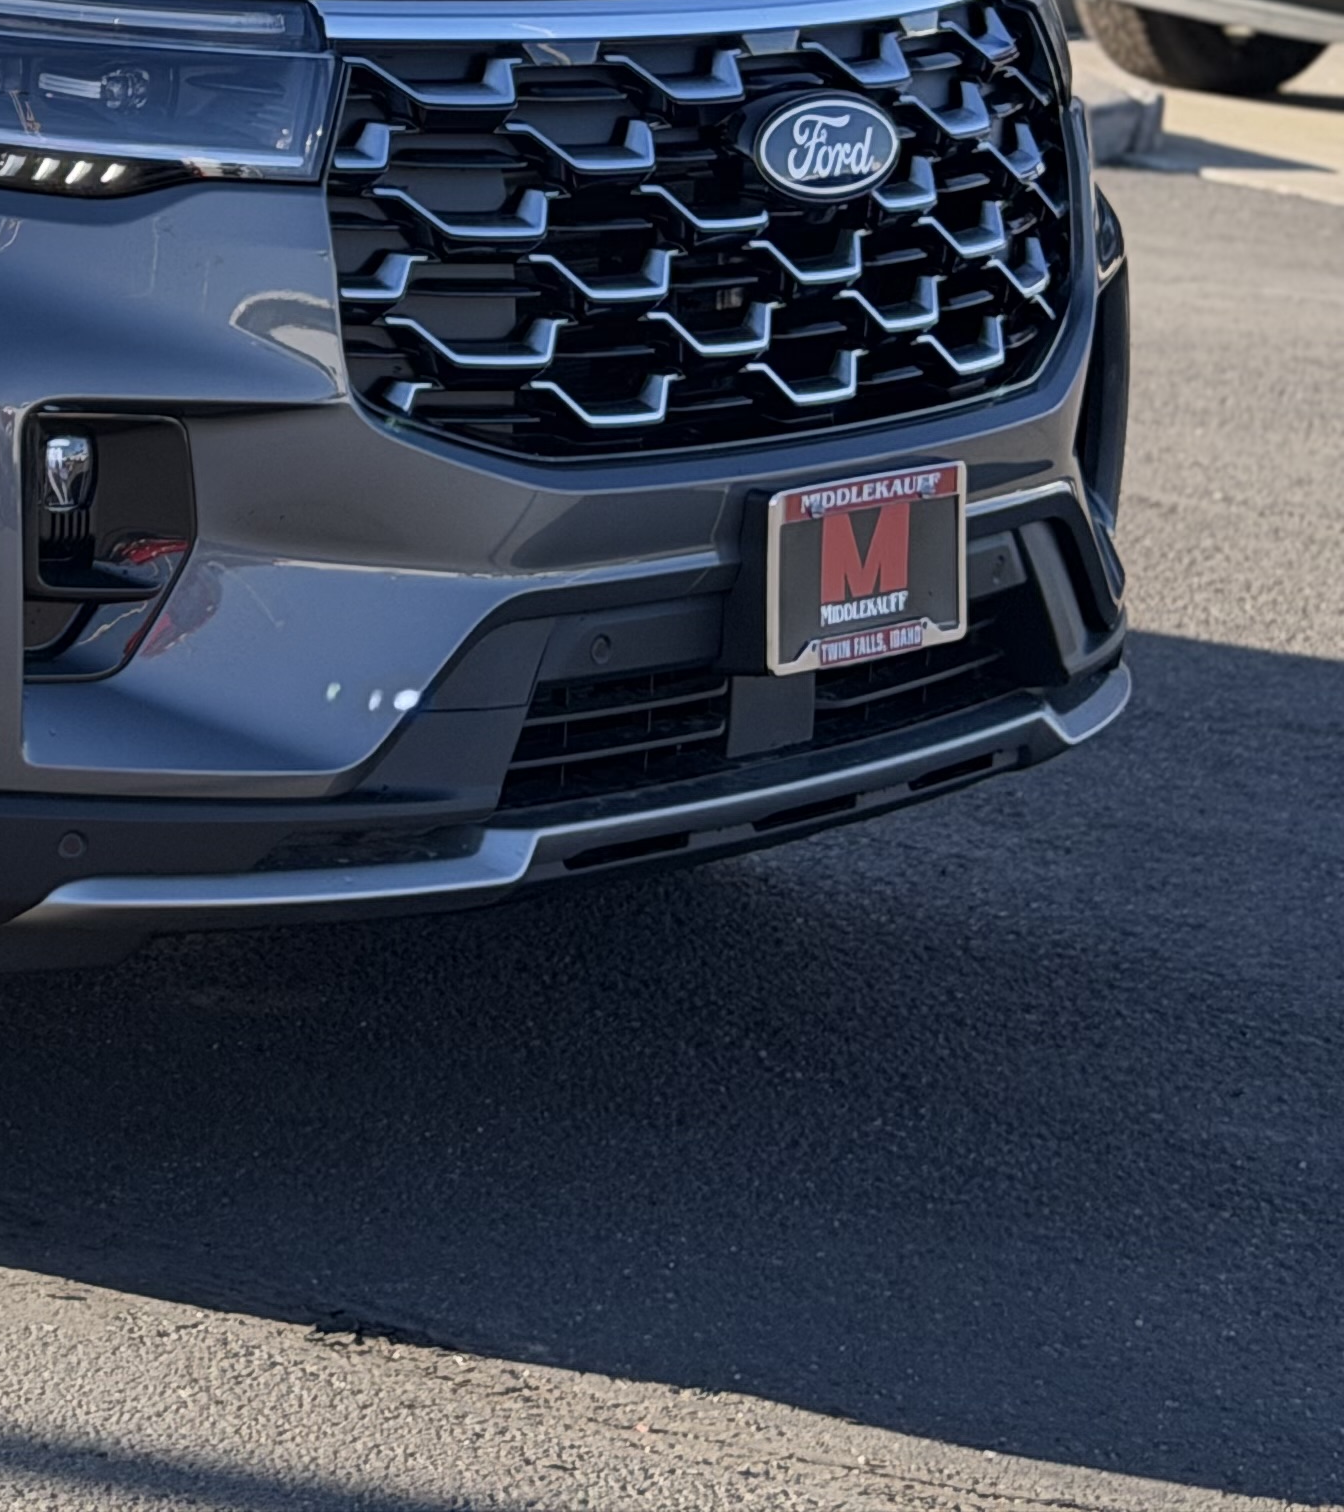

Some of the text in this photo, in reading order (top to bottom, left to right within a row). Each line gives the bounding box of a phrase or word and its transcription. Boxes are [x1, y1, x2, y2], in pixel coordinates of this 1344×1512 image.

[787, 114, 875, 179] Ford
[821, 502, 910, 605] M
[820, 590, 909, 628] MIDDLEKAUFF
[821, 642, 851, 663] TWIN
[890, 626, 922, 650] IDAHO
